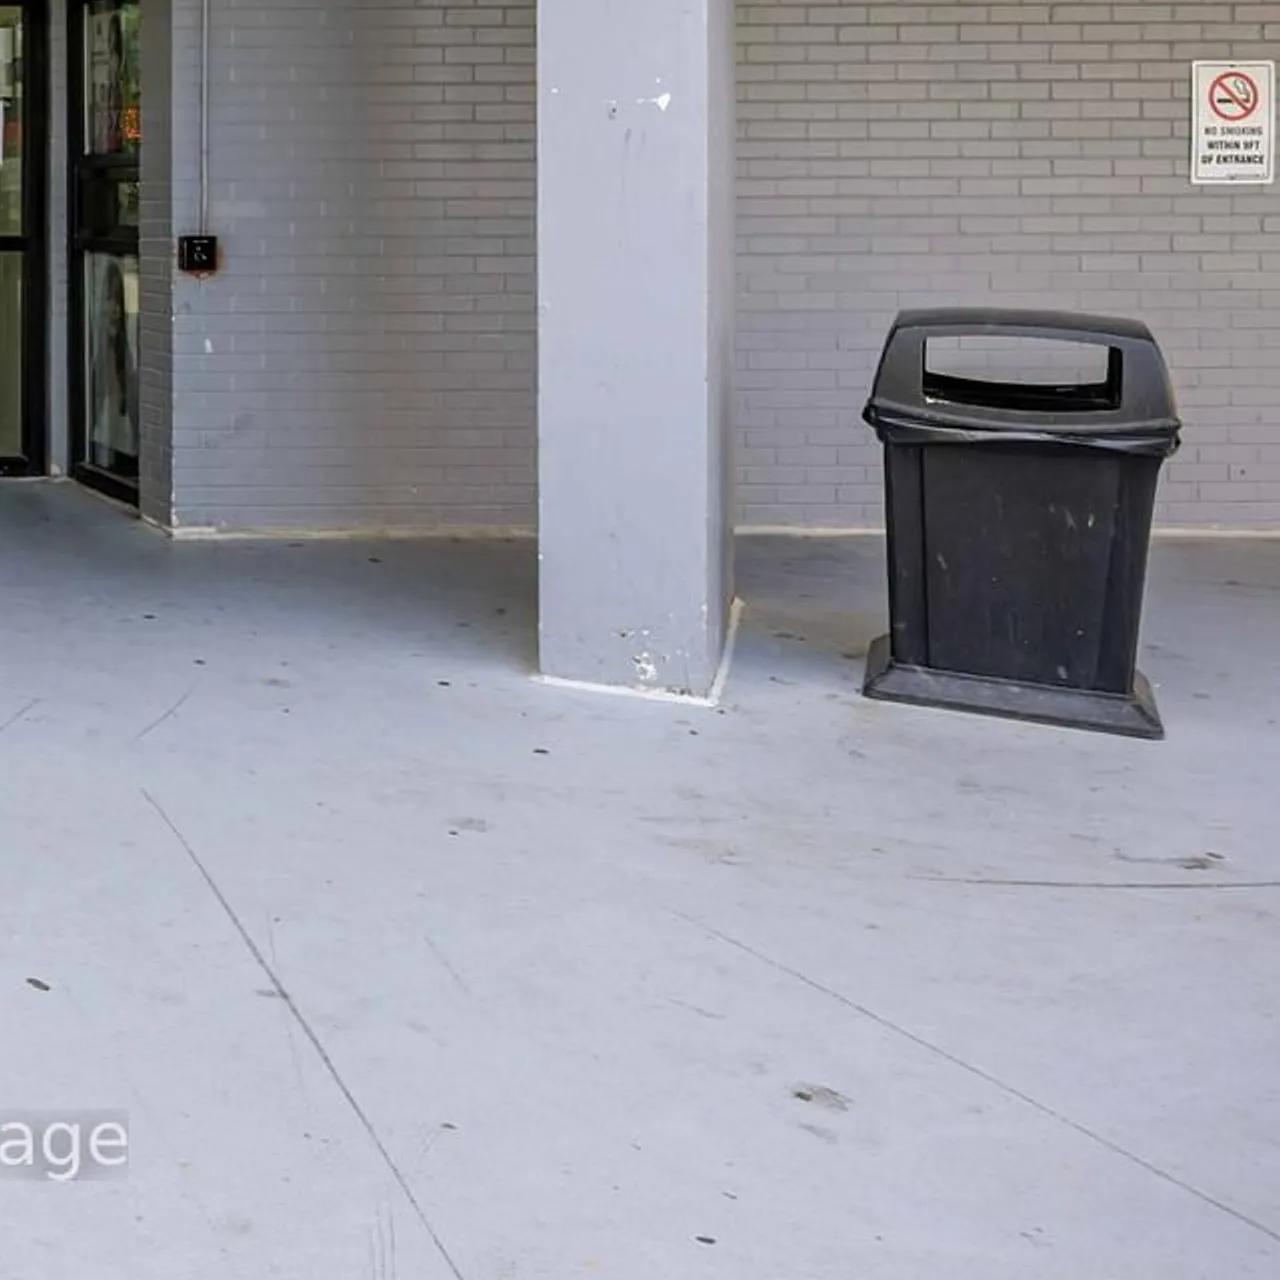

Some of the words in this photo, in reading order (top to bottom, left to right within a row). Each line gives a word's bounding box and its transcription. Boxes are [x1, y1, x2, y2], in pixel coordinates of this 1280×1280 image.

[1204, 126, 1217, 136] NO
[1220, 126, 1263, 136] SMOKING
[1207, 140, 1240, 150] WITHIN
[1201, 154, 1213, 165] OF
[1216, 154, 1264, 165] ENTRANCE
